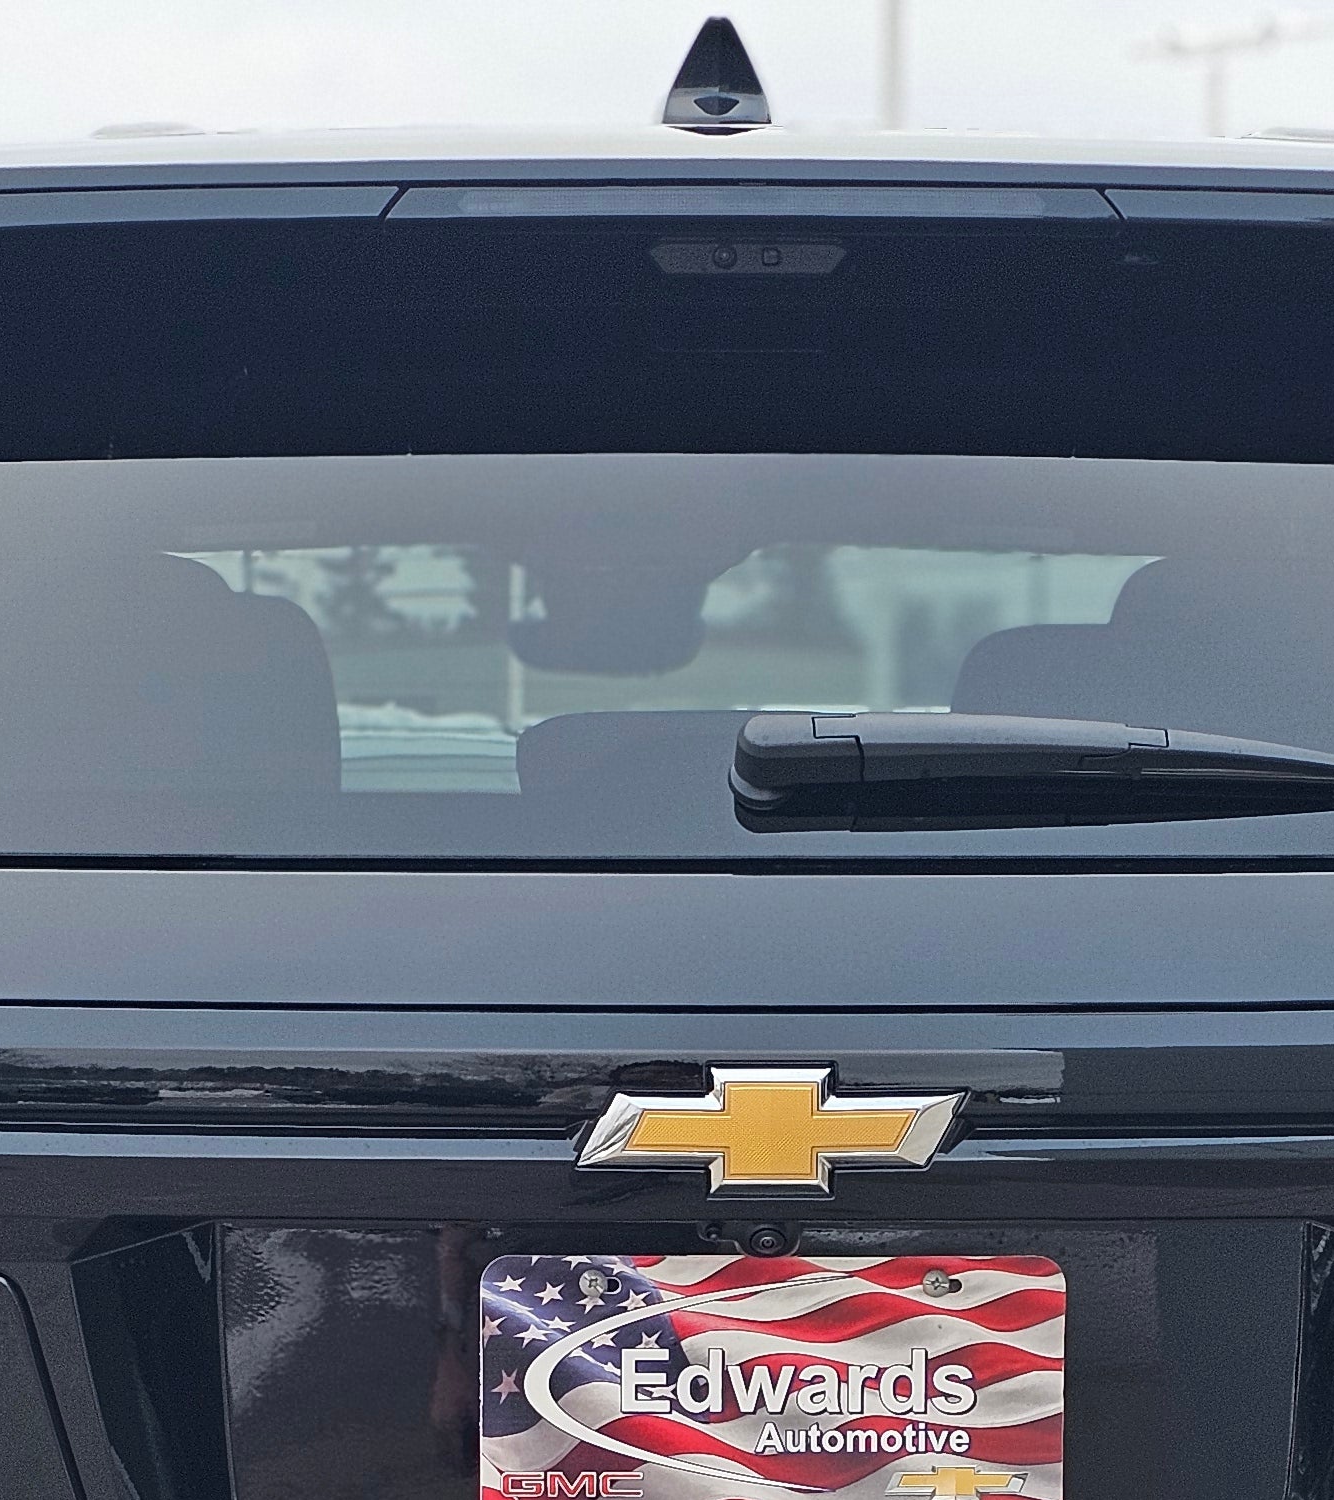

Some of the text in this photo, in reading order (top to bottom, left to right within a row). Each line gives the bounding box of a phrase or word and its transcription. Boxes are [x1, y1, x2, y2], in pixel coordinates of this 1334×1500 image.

[619, 1347, 978, 1415] Edwards
[755, 1422, 970, 1454] Automotive
[499, 1470, 644, 1499] GMC
